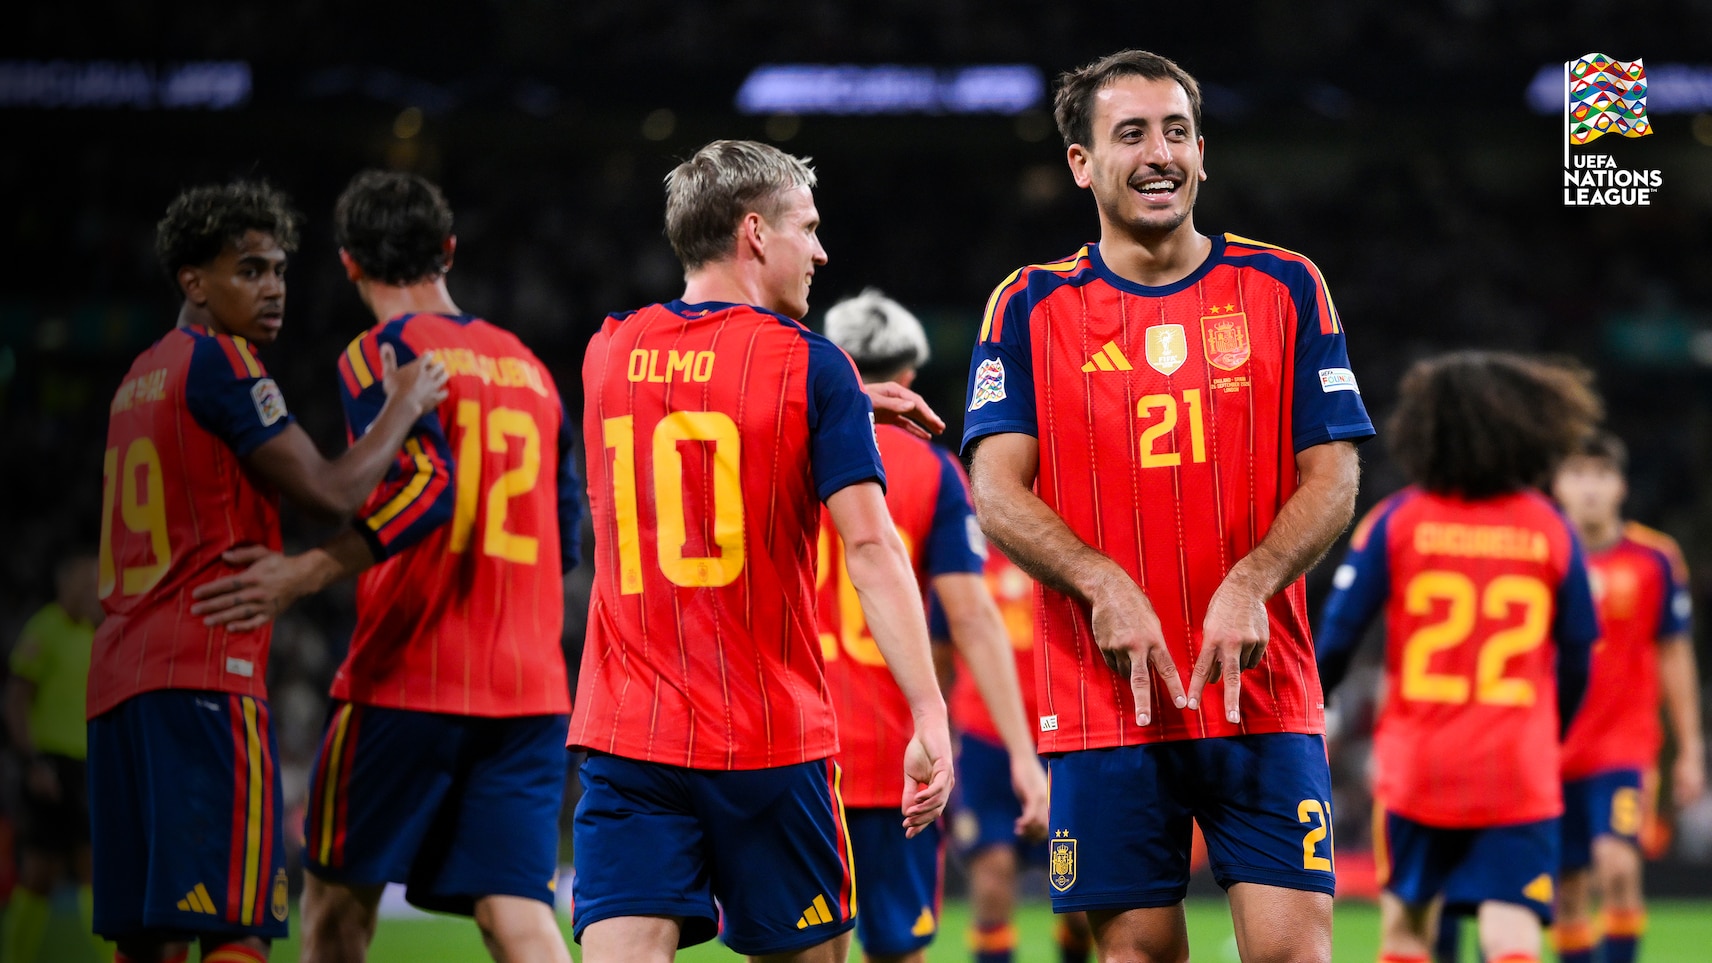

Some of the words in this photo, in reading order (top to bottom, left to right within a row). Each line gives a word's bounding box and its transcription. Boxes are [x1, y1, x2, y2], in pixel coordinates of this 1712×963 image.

[627, 348, 716, 383] OLMO
[1137, 388, 1206, 468] 21
[99, 436, 171, 600] 19
[450, 399, 540, 565] 12
[603, 410, 745, 596] 10
[1402, 569, 1551, 707] 22
